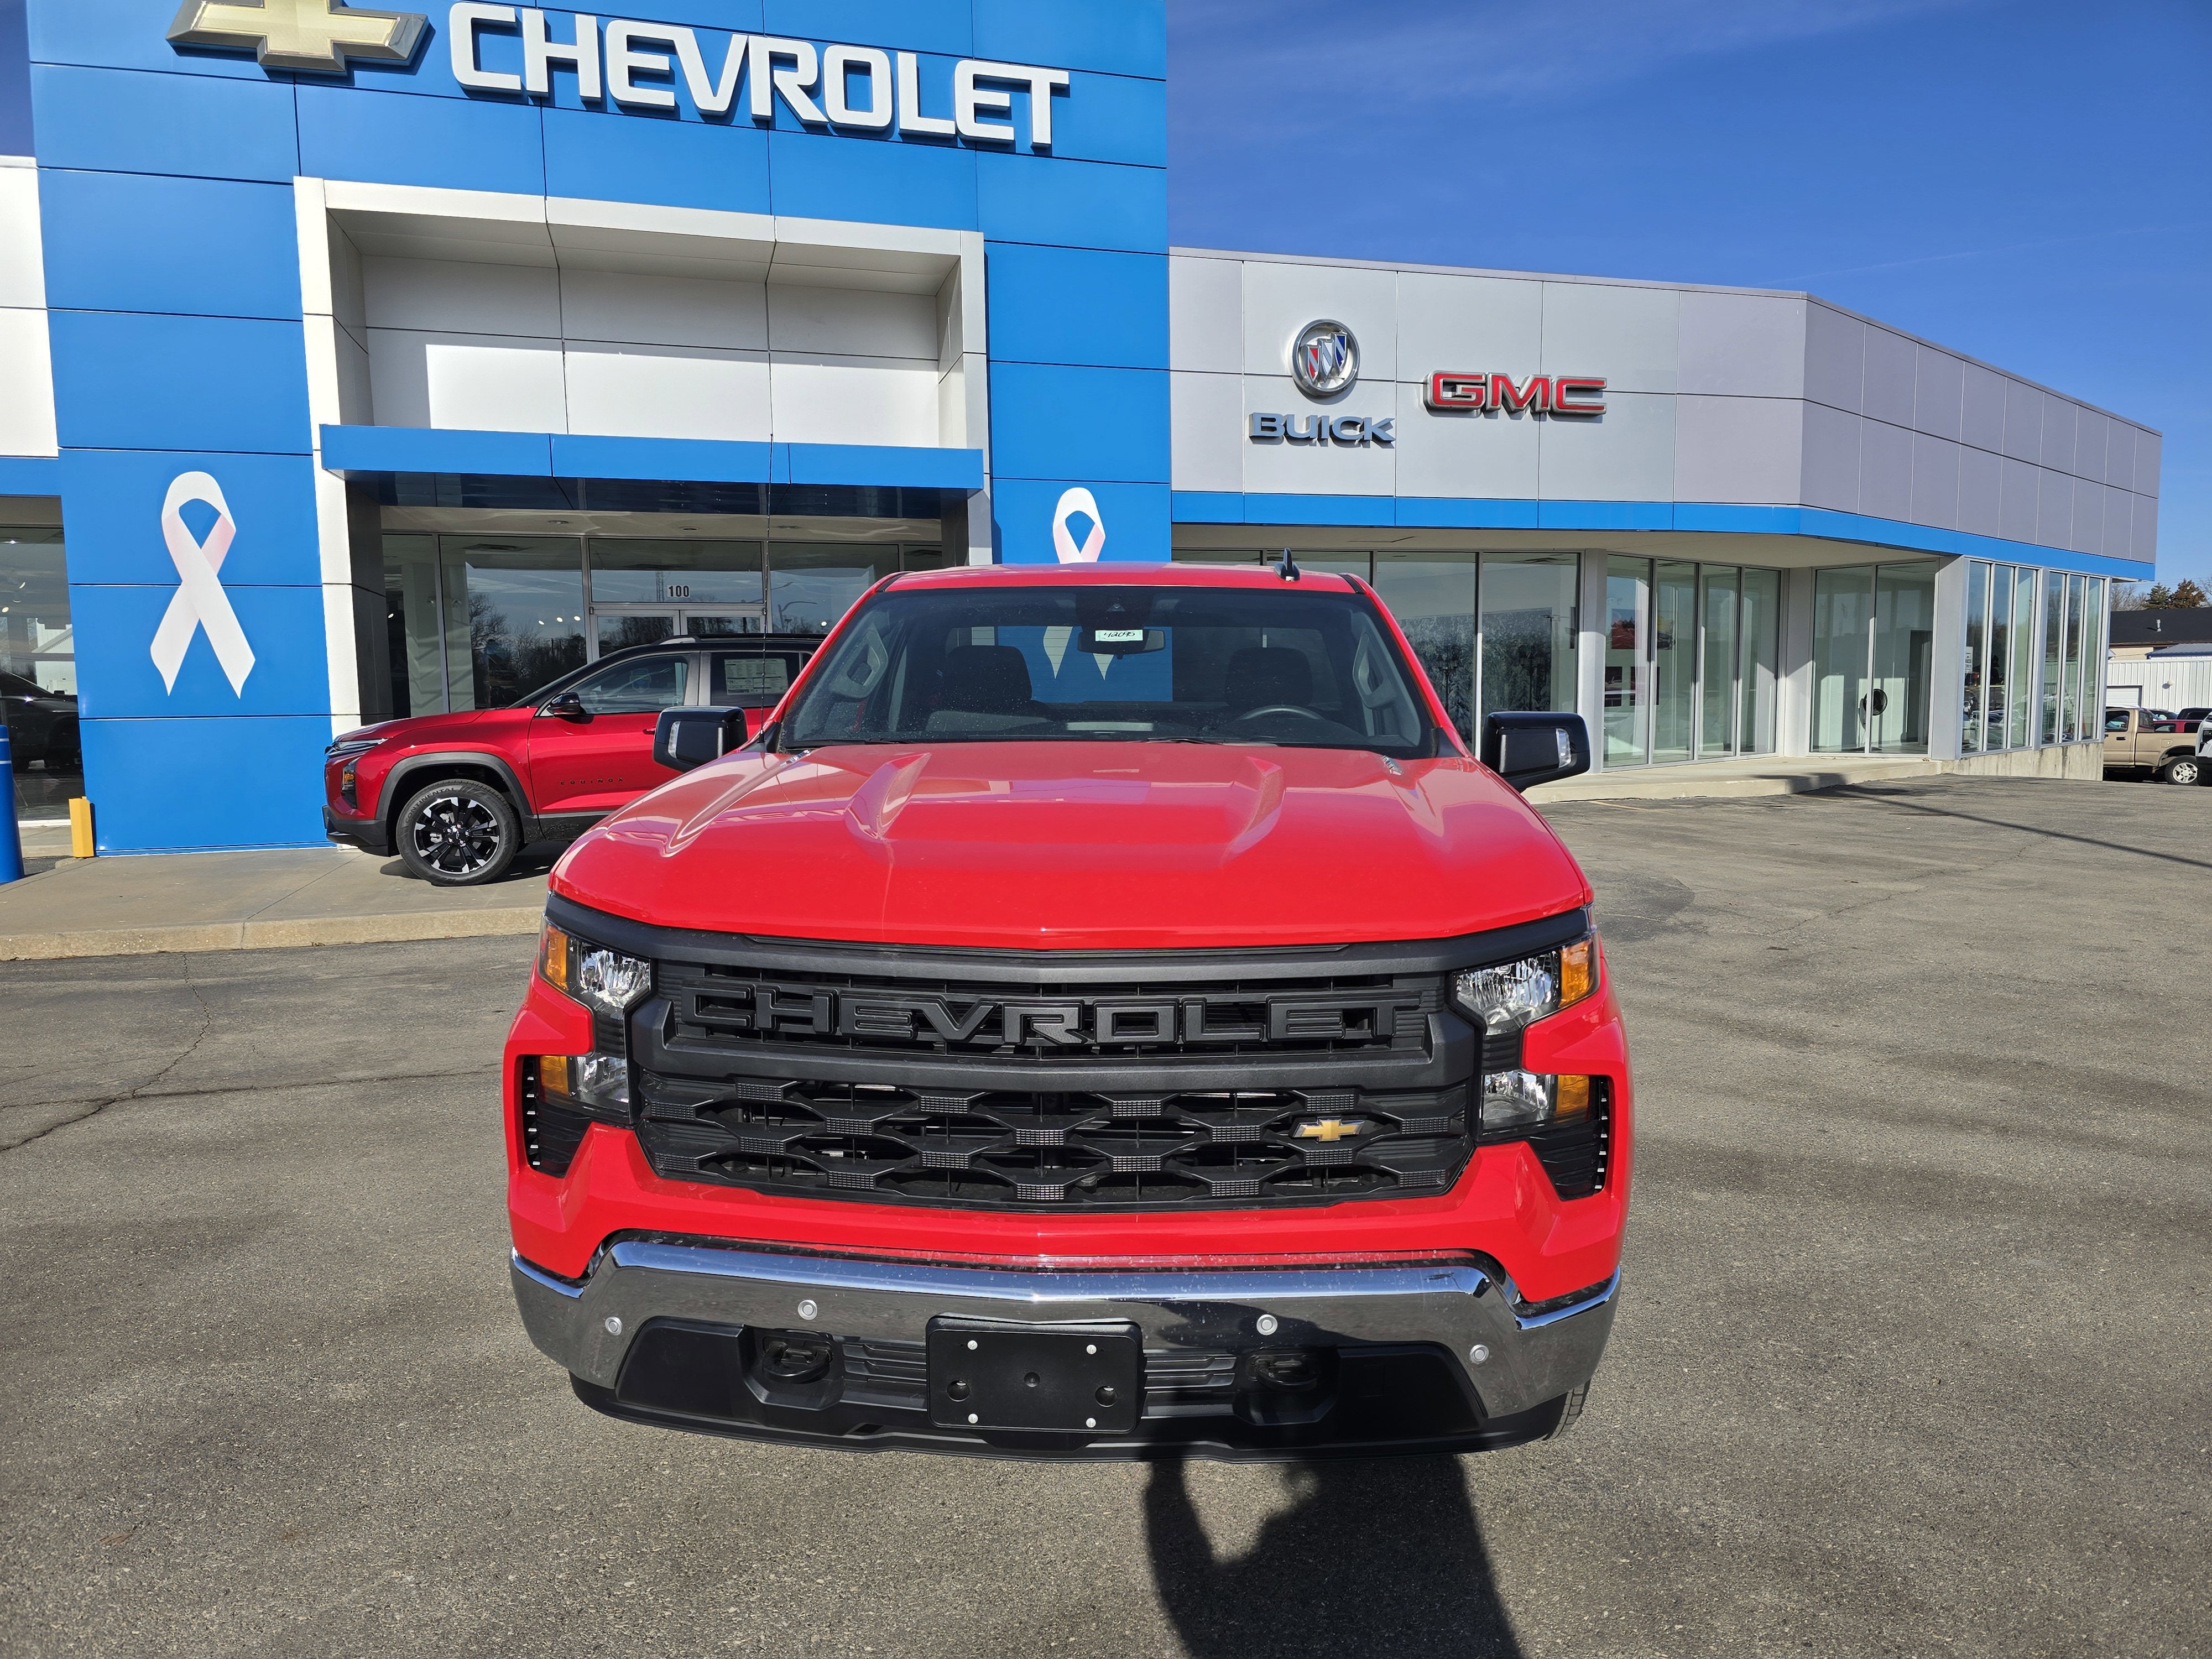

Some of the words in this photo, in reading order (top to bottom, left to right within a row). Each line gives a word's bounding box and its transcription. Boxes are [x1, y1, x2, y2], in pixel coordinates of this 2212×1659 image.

[449, 2, 1069, 148] CHEVROLET
[1425, 370, 1607, 415] GMC
[1249, 412, 1395, 443] BUICK
[669, 585, 689, 597] 100
[405, 787, 457, 823] CONTINENTAL
[681, 979, 1421, 1045] CHEVROLET
